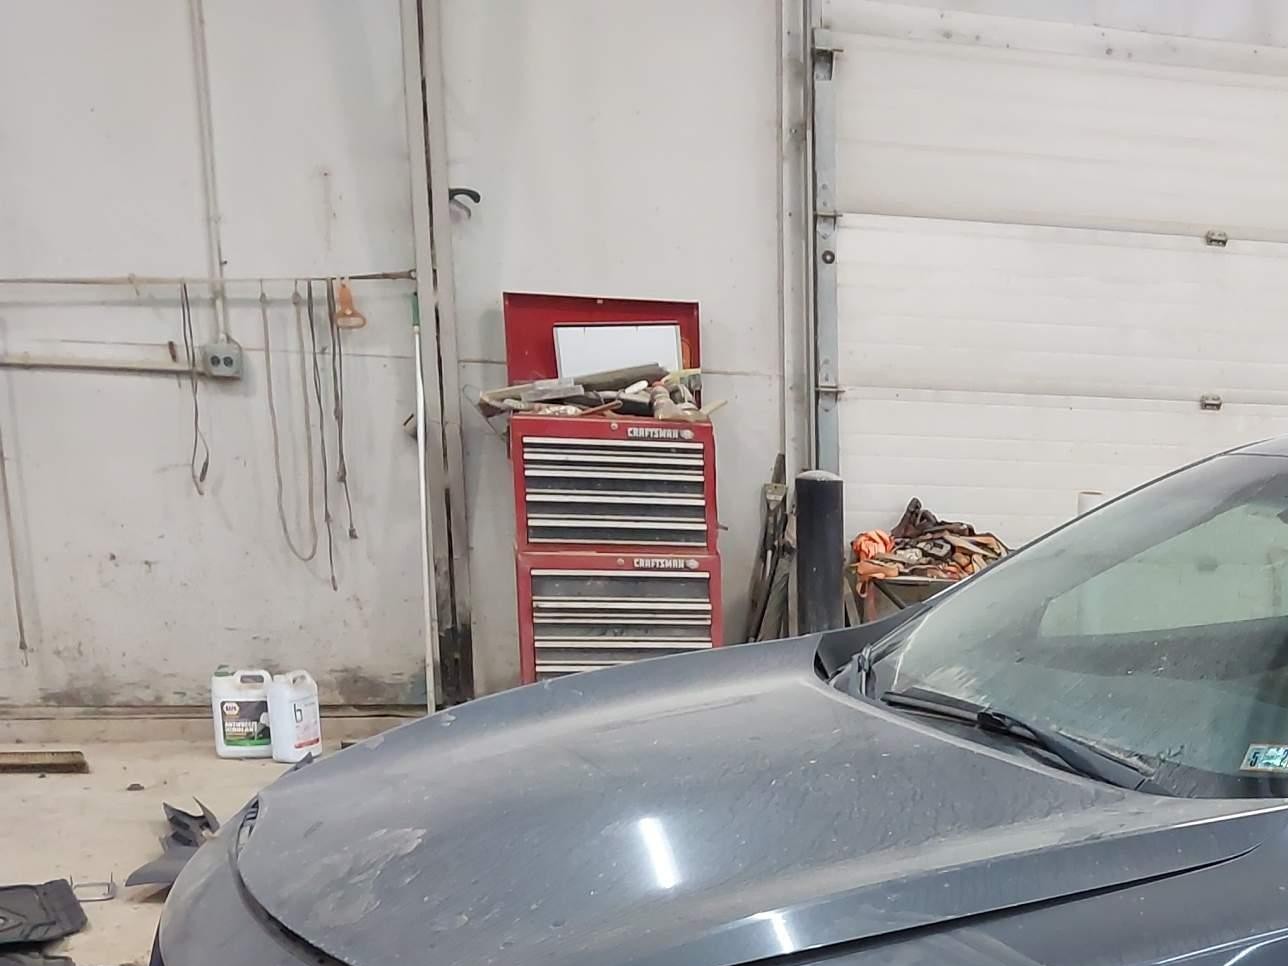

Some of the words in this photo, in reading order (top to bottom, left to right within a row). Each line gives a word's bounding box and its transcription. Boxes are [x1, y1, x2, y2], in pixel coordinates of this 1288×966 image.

[627, 427, 679, 439] CRAFTSMAN
[633, 558, 685, 569] CRAFTSMAN
[1249, 751, 1260, 768] 5
